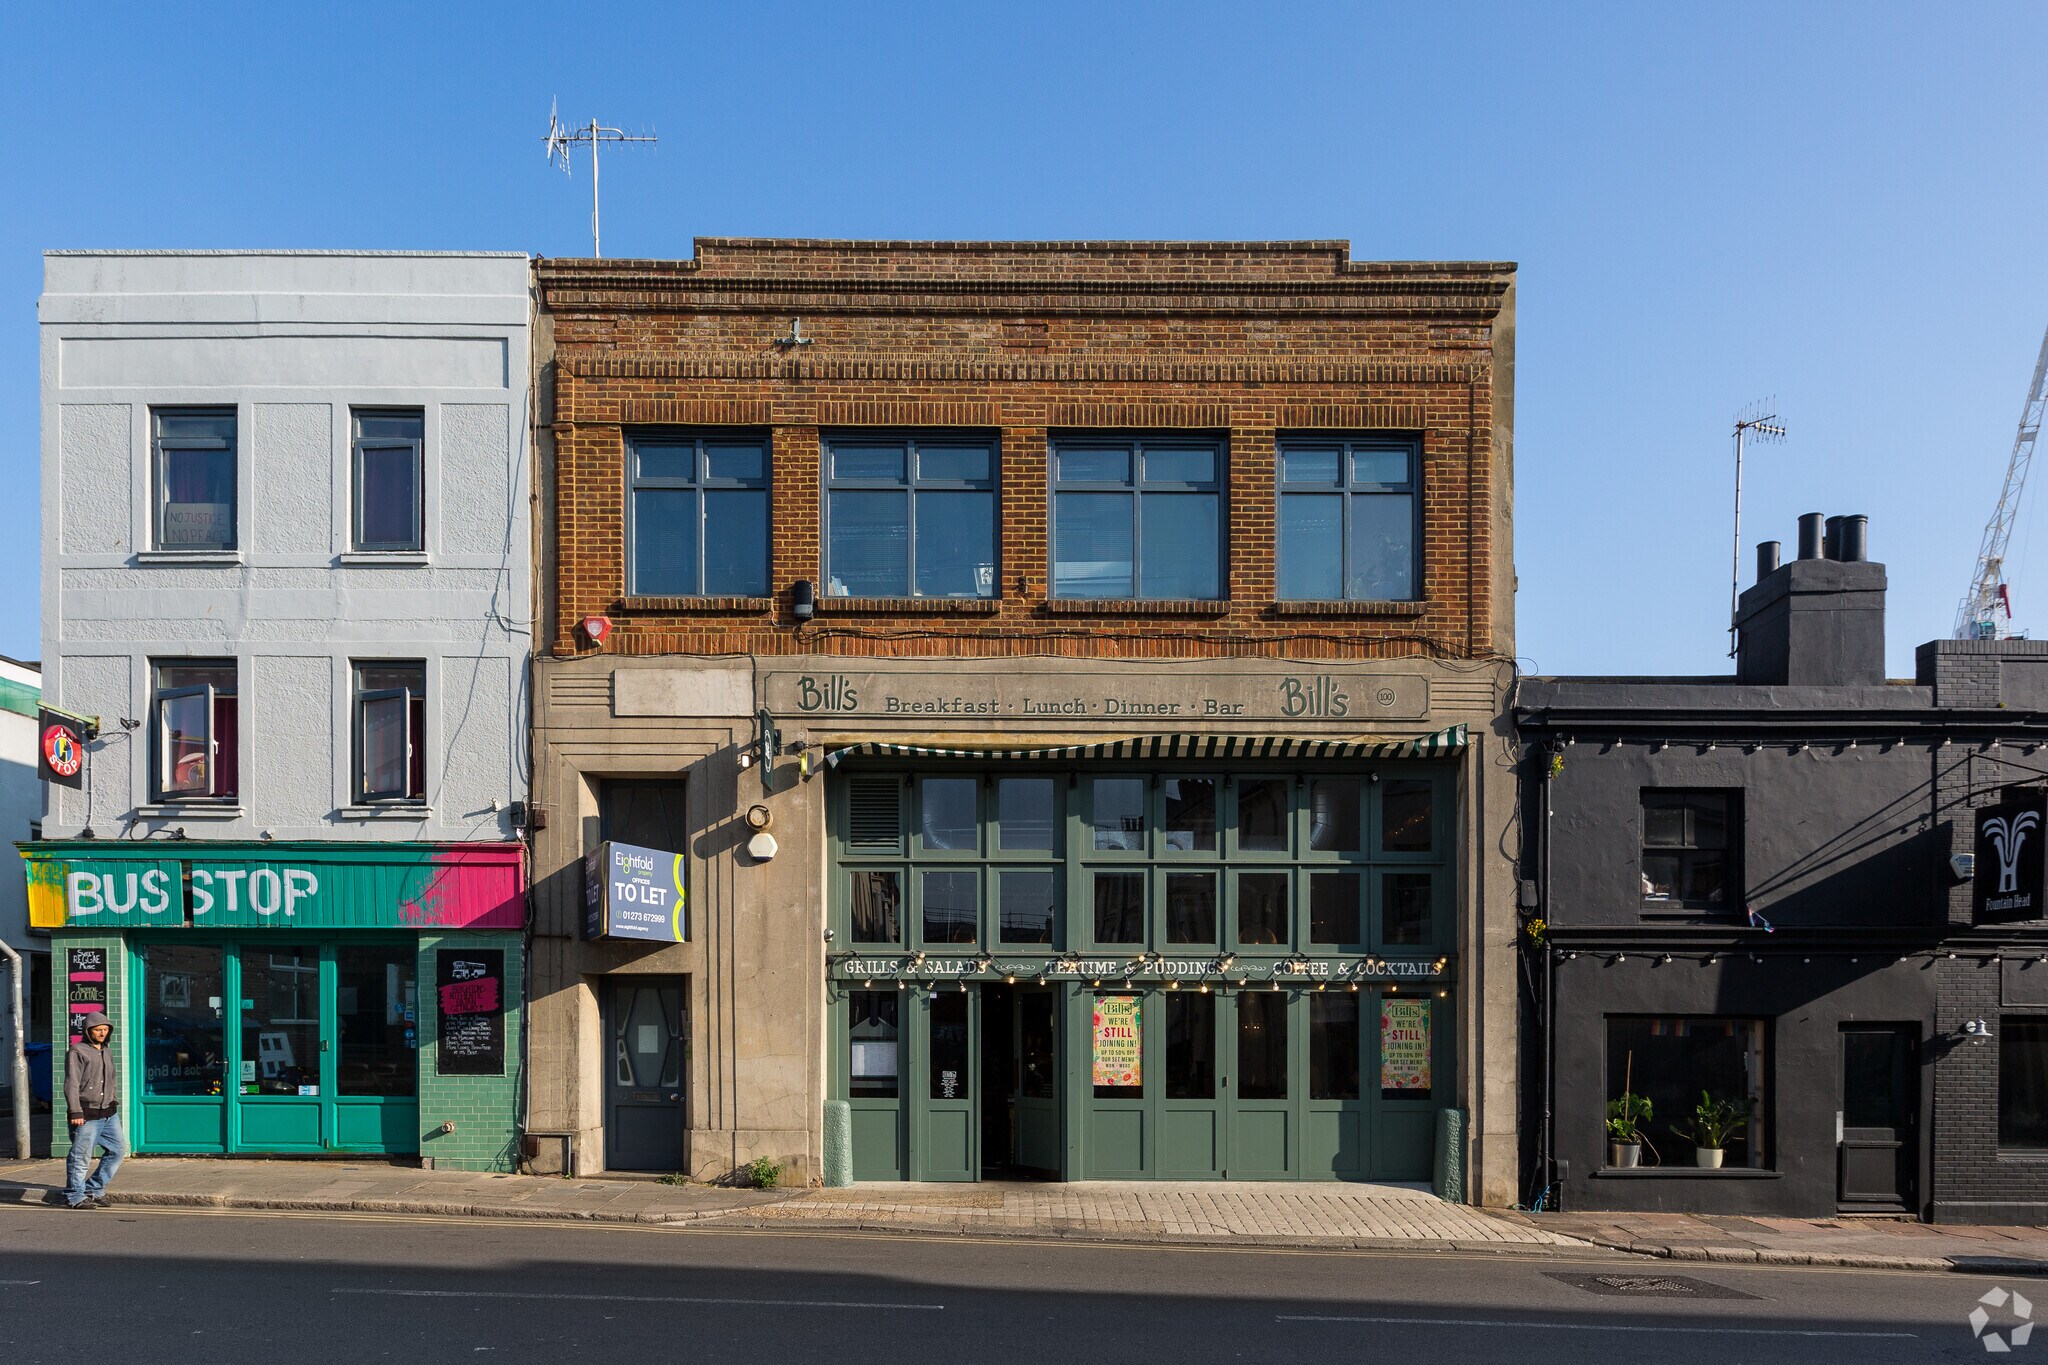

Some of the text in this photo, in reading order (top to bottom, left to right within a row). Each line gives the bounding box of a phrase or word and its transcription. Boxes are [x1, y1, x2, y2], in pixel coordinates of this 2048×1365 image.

[170, 512, 225, 526] NO JUSTICE
[172, 529, 227, 542] NO PEACE
[797, 675, 858, 711] Bill's
[1279, 675, 1349, 717] Bill's
[1379, 693, 1392, 701] 100
[884, 697, 1245, 716] Breakfast Lunch Dinner Bar
[50, 754, 78, 775] STOP
[67, 869, 170, 917] BUS
[192, 868, 319, 917] STOP
[614, 882, 637, 903] TO
[641, 885, 668, 906] LET
[1985, 893, 2031, 911] Fountain Head
[622, 910, 643, 921] 01273
[845, 960, 986, 974] GRILLS & SALADS
[1045, 961, 1226, 975] TEATIME & PUDDINGS
[1273, 962, 1442, 976] COFFEE & COCKTAILS
[1108, 1017, 1128, 1025] WE'RE
[1395, 1020, 1416, 1028] WE'RE
[1104, 1027, 1133, 1038] STILL
[1392, 1029, 1420, 1040] STILL
[1099, 1039, 1137, 1048] JOINING IN!
[1387, 1042, 1425, 1050] JOINING IN!
